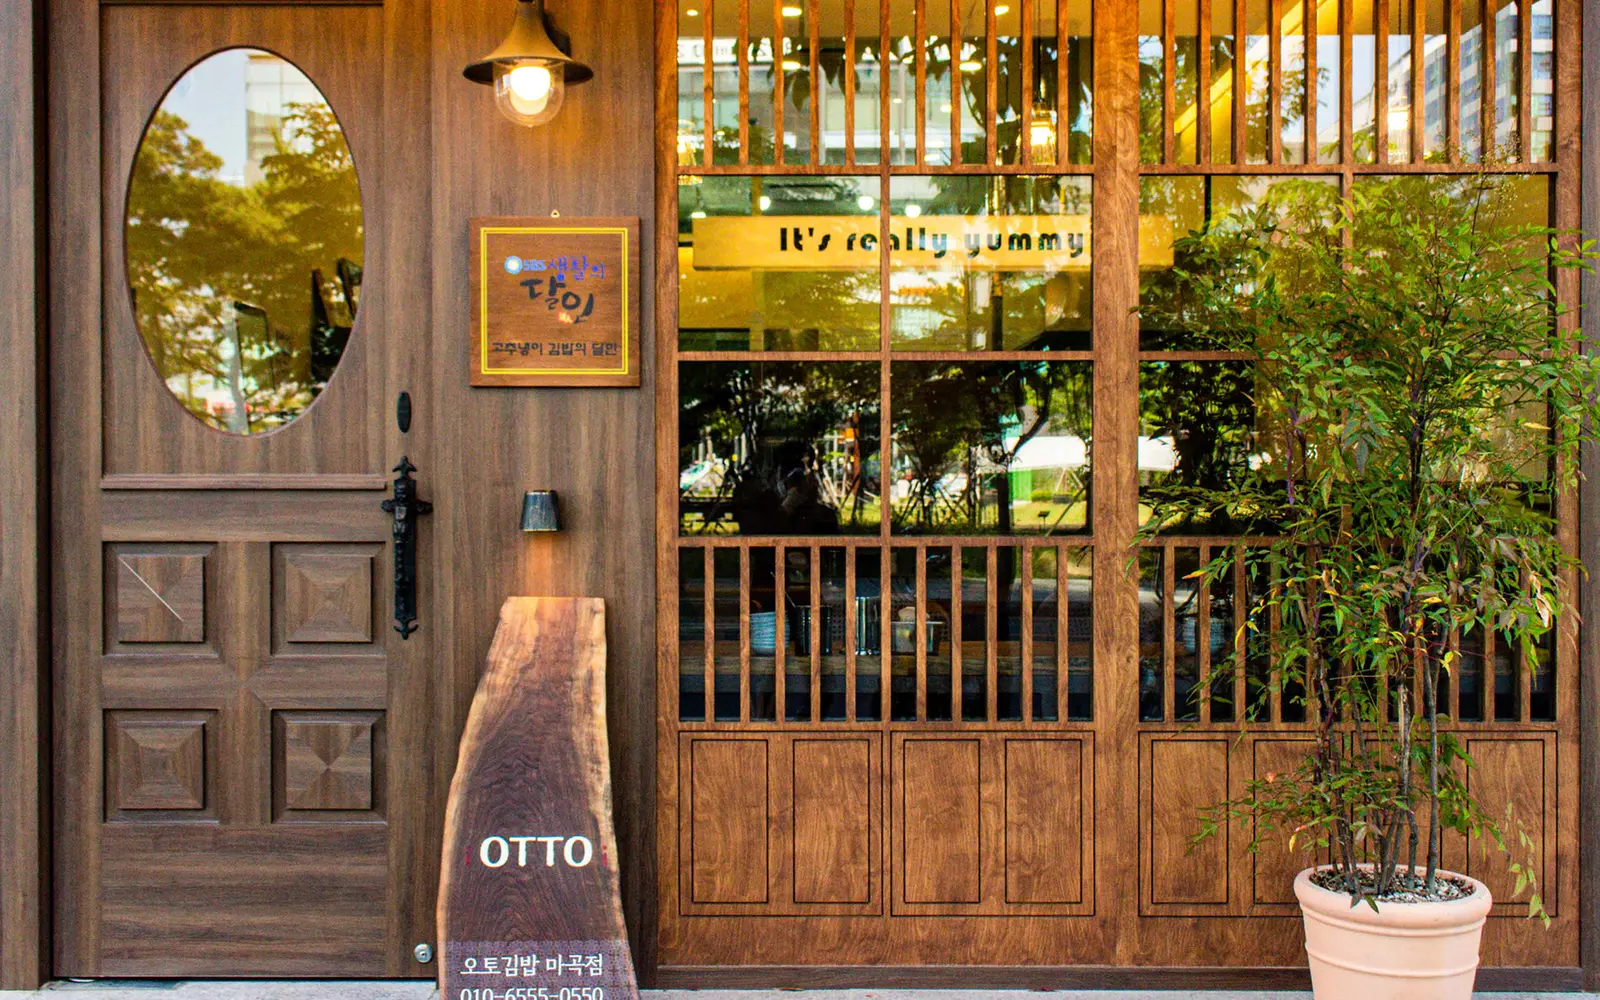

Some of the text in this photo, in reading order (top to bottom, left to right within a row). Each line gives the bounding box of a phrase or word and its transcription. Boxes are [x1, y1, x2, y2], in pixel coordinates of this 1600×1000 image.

[780, 227, 1084, 258] It's really yummy
[523, 259, 547, 271] SBS
[520, 275, 595, 324] 달인
[548, 341, 587, 356] 김밥의
[479, 836, 593, 868] OTTO
[460, 953, 603, 977] 오토김밥 마곡점
[460, 987, 604, 1000] 010-6555-0550
